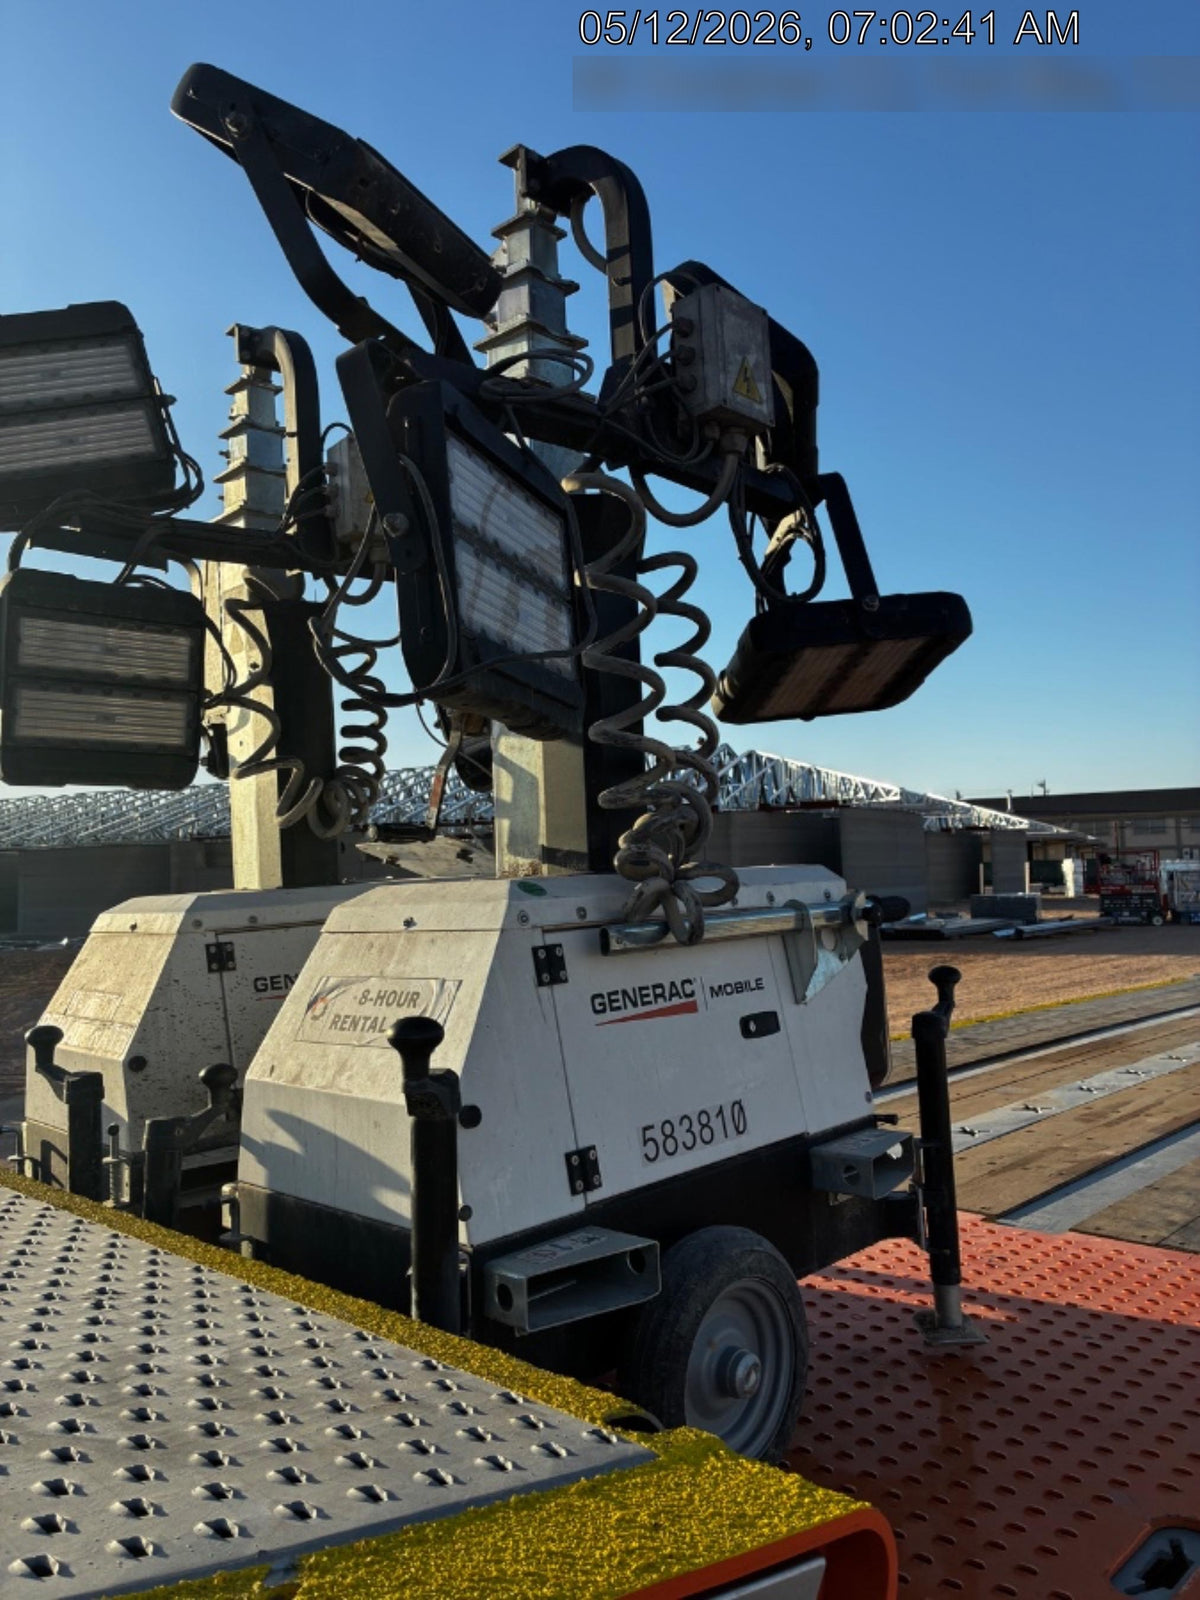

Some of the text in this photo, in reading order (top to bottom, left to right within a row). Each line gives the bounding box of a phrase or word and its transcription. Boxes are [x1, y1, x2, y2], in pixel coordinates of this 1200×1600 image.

[358, 988, 421, 1009] 8-HOUR
[590, 977, 765, 1015] GENERAC MOBILE
[328, 1014, 388, 1034] RENTAL
[641, 1098, 748, 1163] 583810
